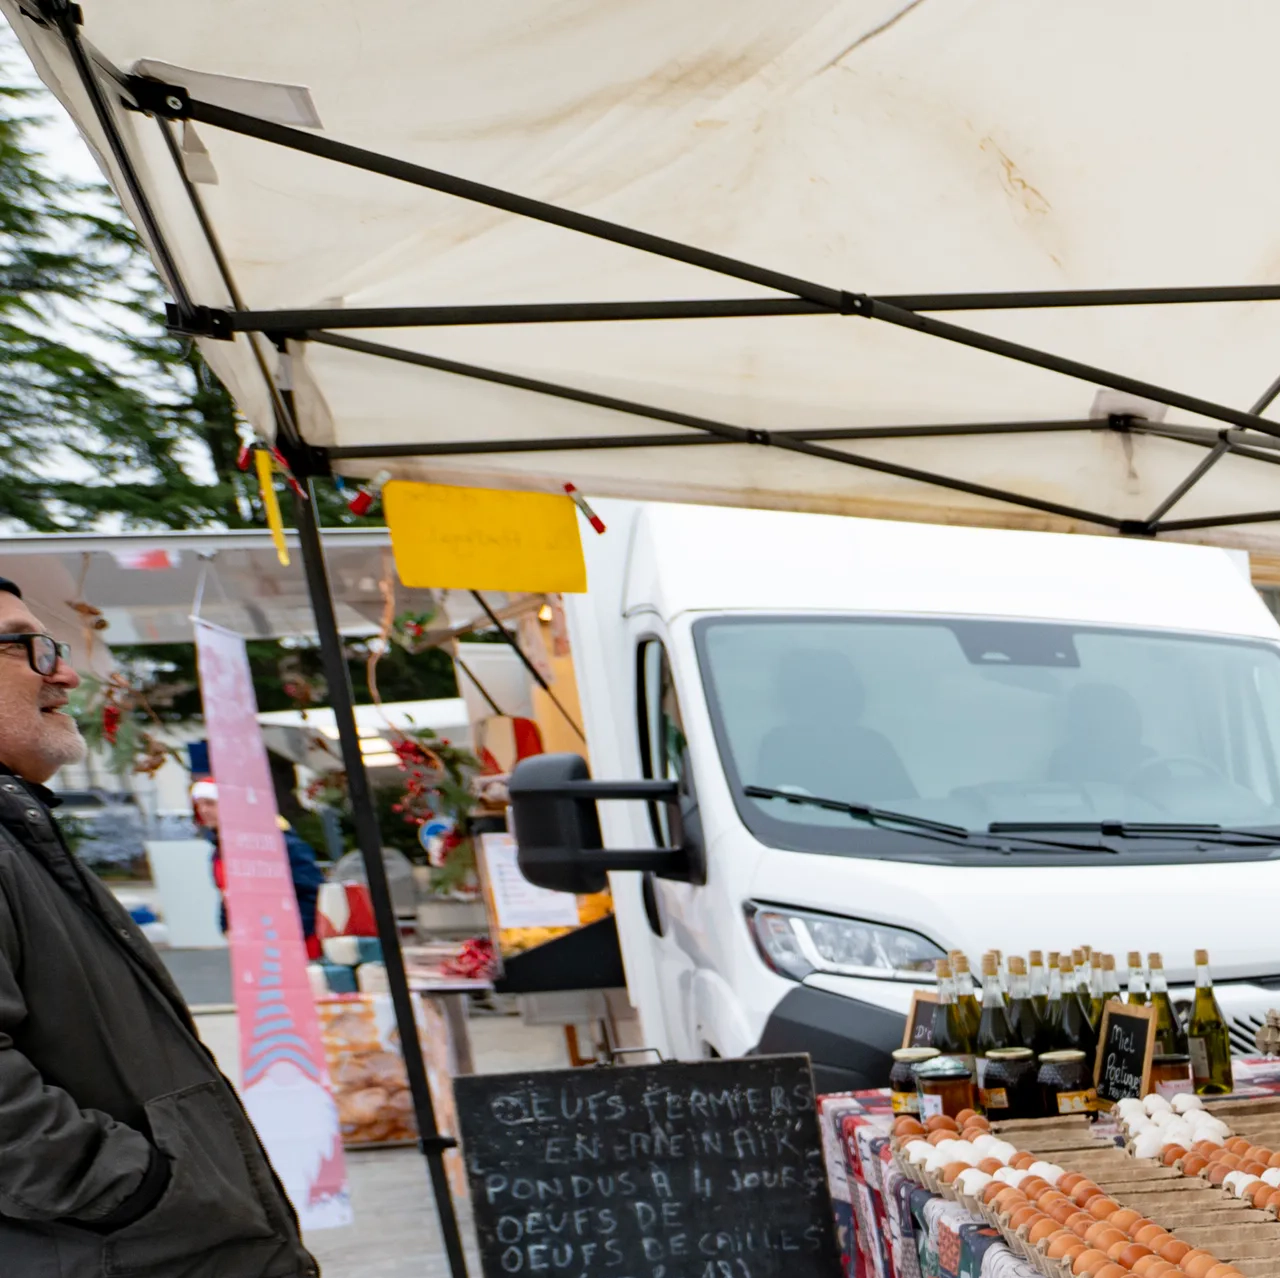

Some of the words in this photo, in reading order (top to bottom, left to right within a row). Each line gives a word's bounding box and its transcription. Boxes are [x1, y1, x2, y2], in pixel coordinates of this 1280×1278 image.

[485, 1171, 637, 1204] PONDUS
[496, 1208, 618, 1244] OEUFS
[634, 1201, 683, 1232] DE
[501, 1238, 624, 1273] OEUFS
[641, 1232, 688, 1262] DE
